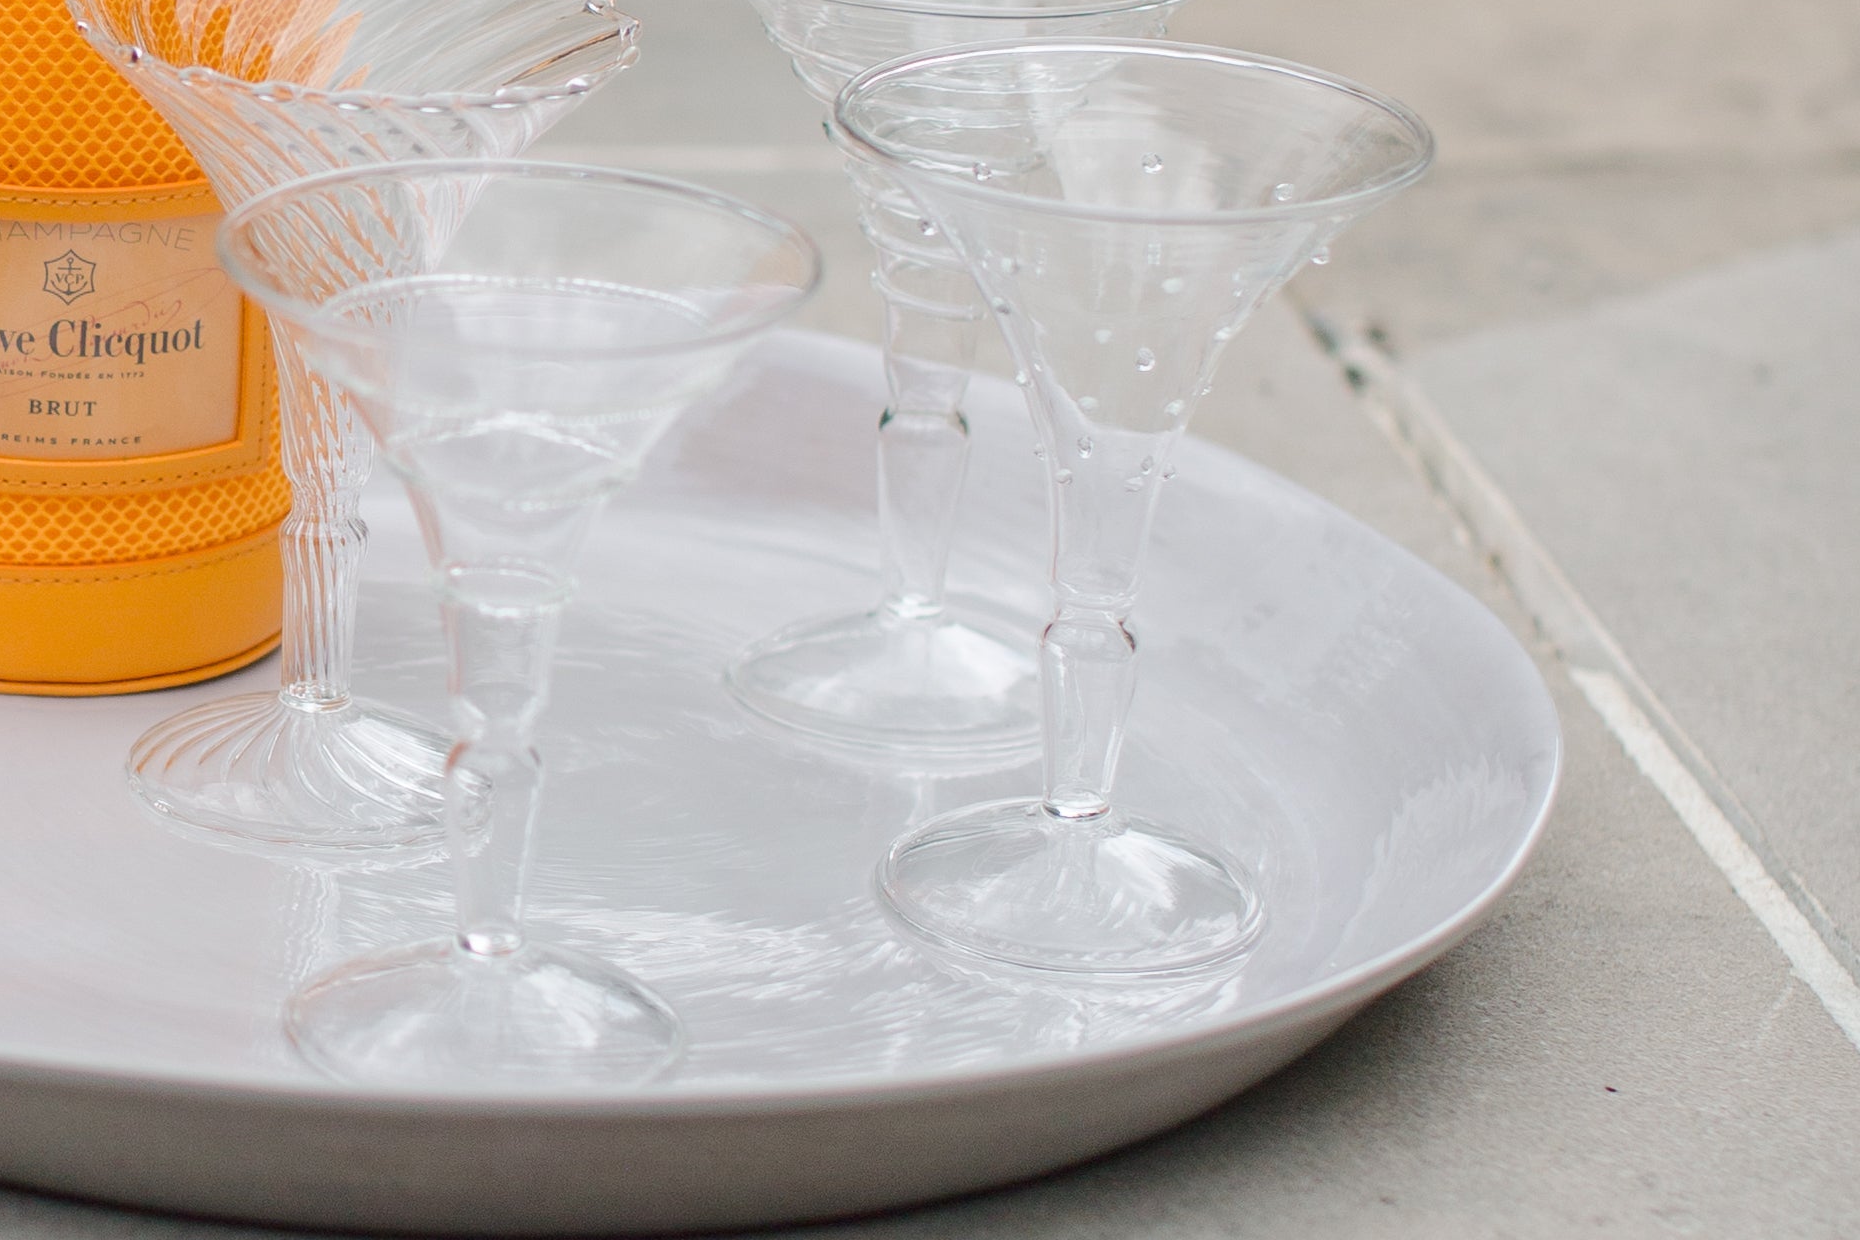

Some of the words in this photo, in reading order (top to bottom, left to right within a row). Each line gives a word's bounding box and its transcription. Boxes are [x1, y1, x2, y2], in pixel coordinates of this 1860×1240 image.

[48, 318, 205, 365] Clicquot
[28, 398, 97, 417] BRUT
[1, 432, 57, 445] REIMS
[71, 435, 142, 445] FRANCE
